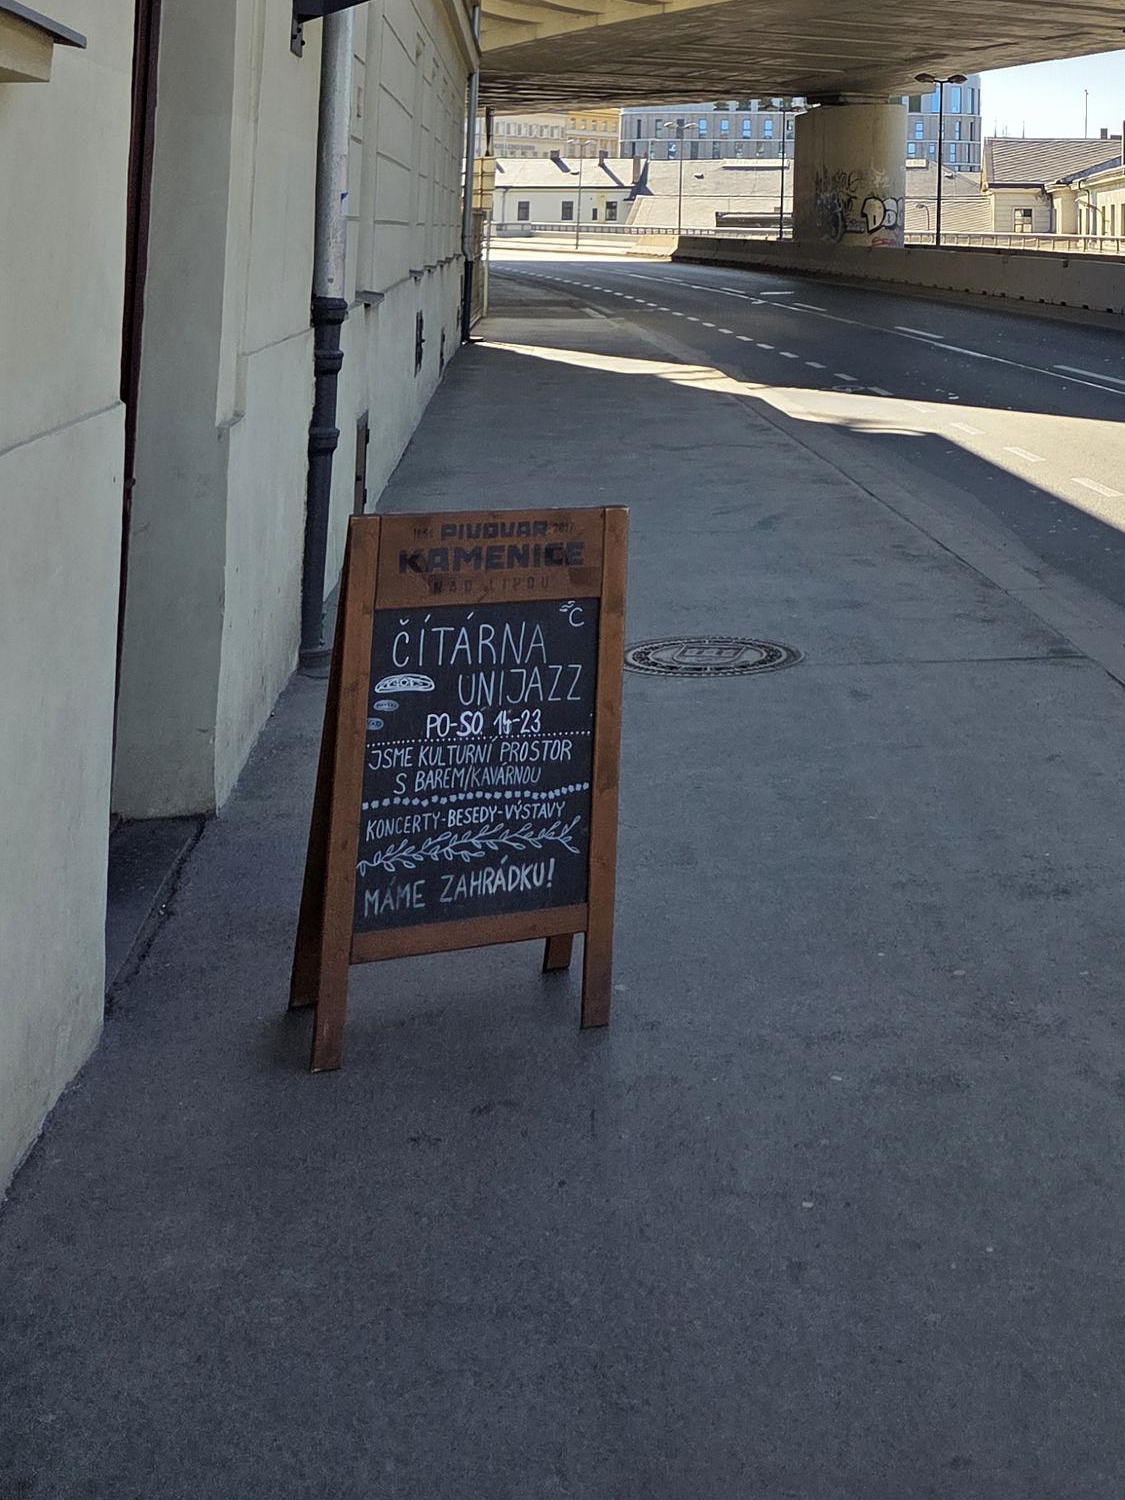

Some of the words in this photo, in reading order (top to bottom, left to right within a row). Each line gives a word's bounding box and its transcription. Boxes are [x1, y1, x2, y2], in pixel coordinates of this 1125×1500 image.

[399, 541, 586, 575] KAMENICE
[392, 611, 547, 668] ČÍTÁRNA
[457, 664, 583, 707] UNIJAZZ
[368, 746, 414, 771] JSME
[418, 736, 499, 768] KULTURNÍ
[499, 739, 573, 764] PROSTOR
[392, 772, 408, 795] S
[414, 762, 542, 792] BAREM/KAVÁRNOU
[364, 875, 426, 918] MÁME
[439, 854, 556, 904] ZAHRÁDKU!
